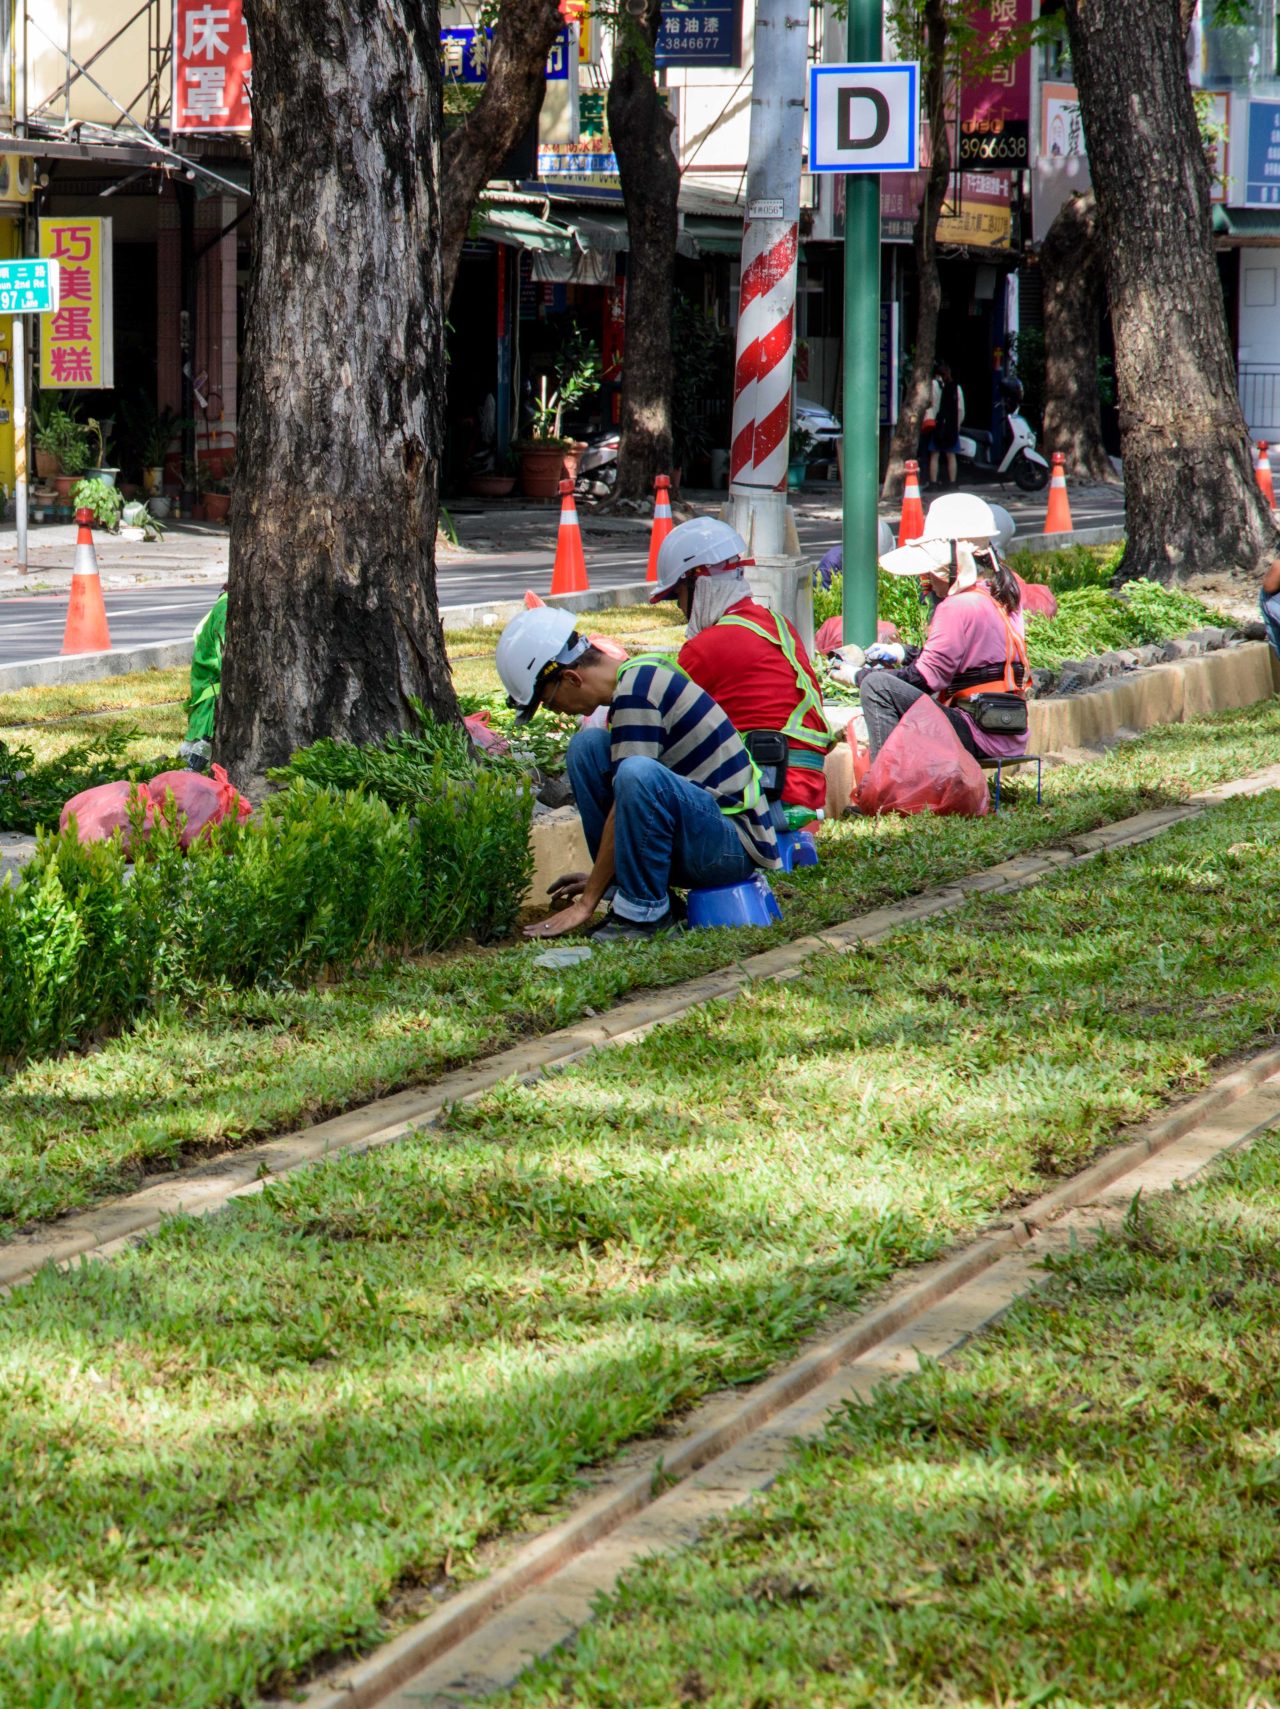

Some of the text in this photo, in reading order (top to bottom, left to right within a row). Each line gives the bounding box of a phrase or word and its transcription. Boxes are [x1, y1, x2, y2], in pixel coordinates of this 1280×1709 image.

[658, 17, 719, 33] 裕油漆
[183, 4, 230, 121] 床罩
[837, 86, 890, 150] D
[960, 137, 1027, 159] 3966638
[14, 280, 31, 290] 2nd
[33, 279, 47, 289] Rd.
[50, 226, 93, 382] 巧美蛋糕
